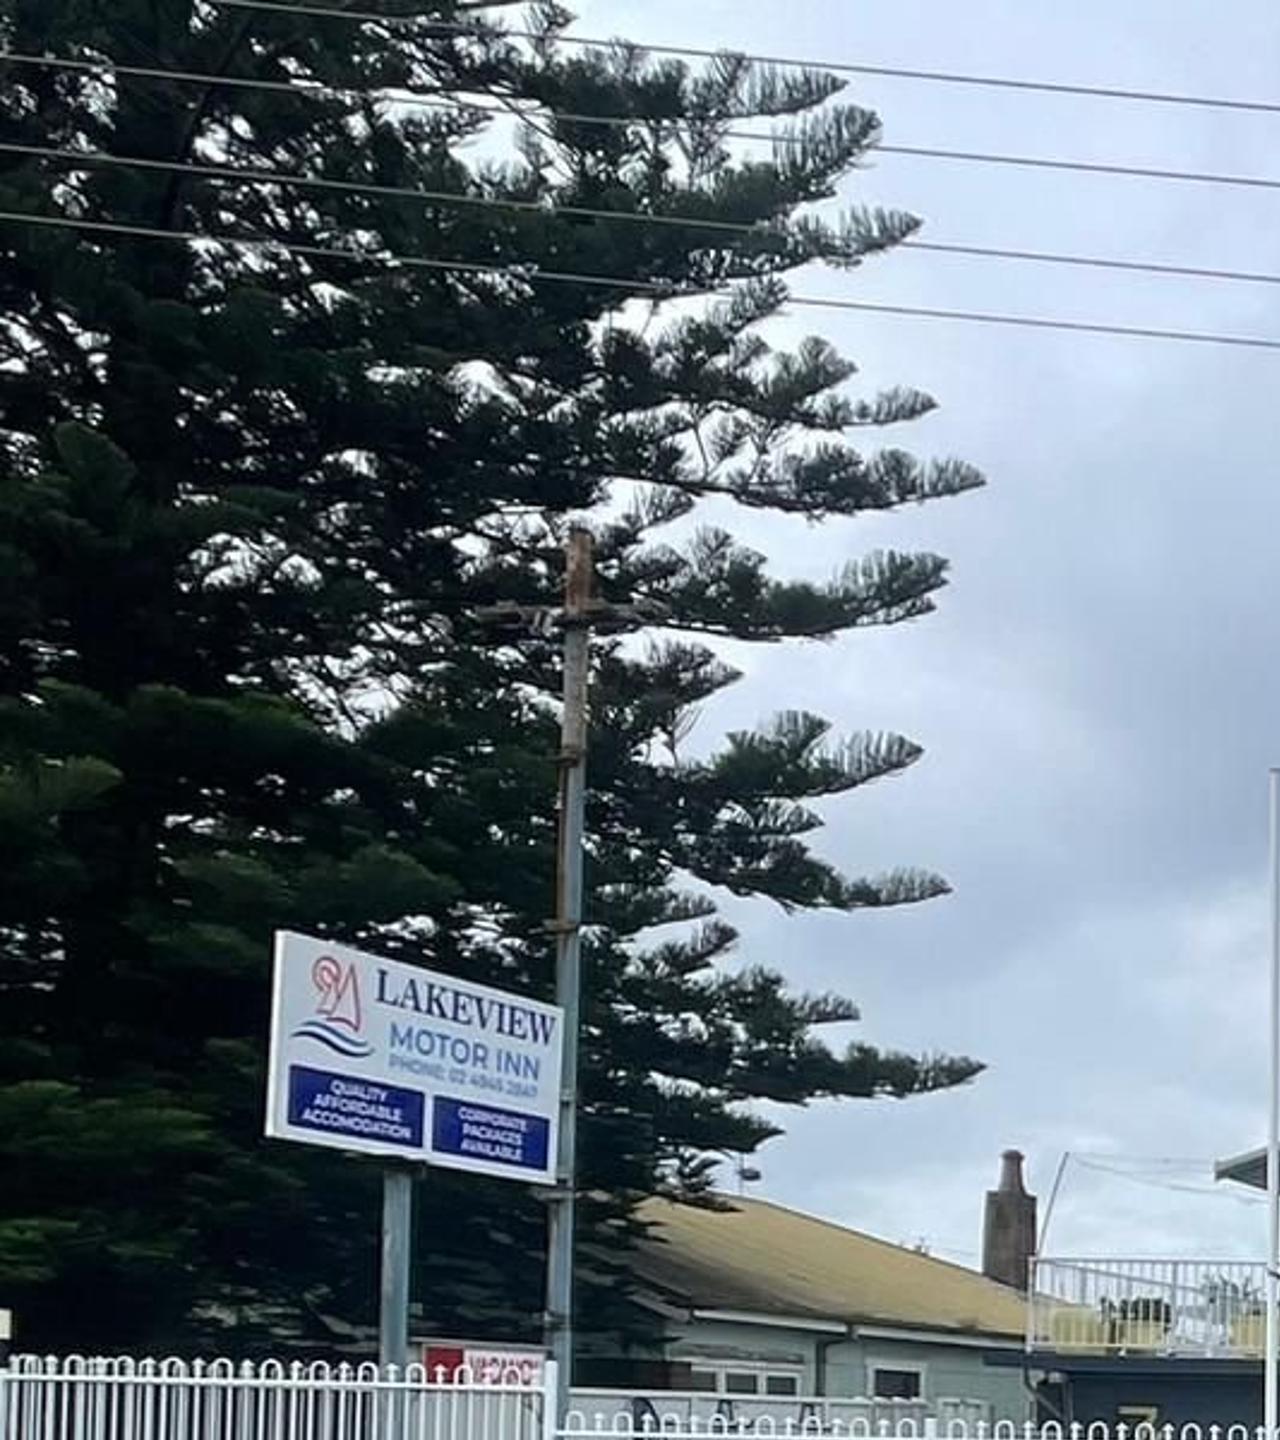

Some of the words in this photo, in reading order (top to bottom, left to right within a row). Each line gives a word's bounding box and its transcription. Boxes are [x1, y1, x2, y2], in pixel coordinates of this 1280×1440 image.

[375, 968, 556, 1047] LAKEVIEW
[389, 1022, 488, 1070] MOTOR
[496, 1048, 539, 1081] INN
[313, 1093, 402, 1123] AFFORDABLE
[329, 1079, 388, 1102] QUALITY
